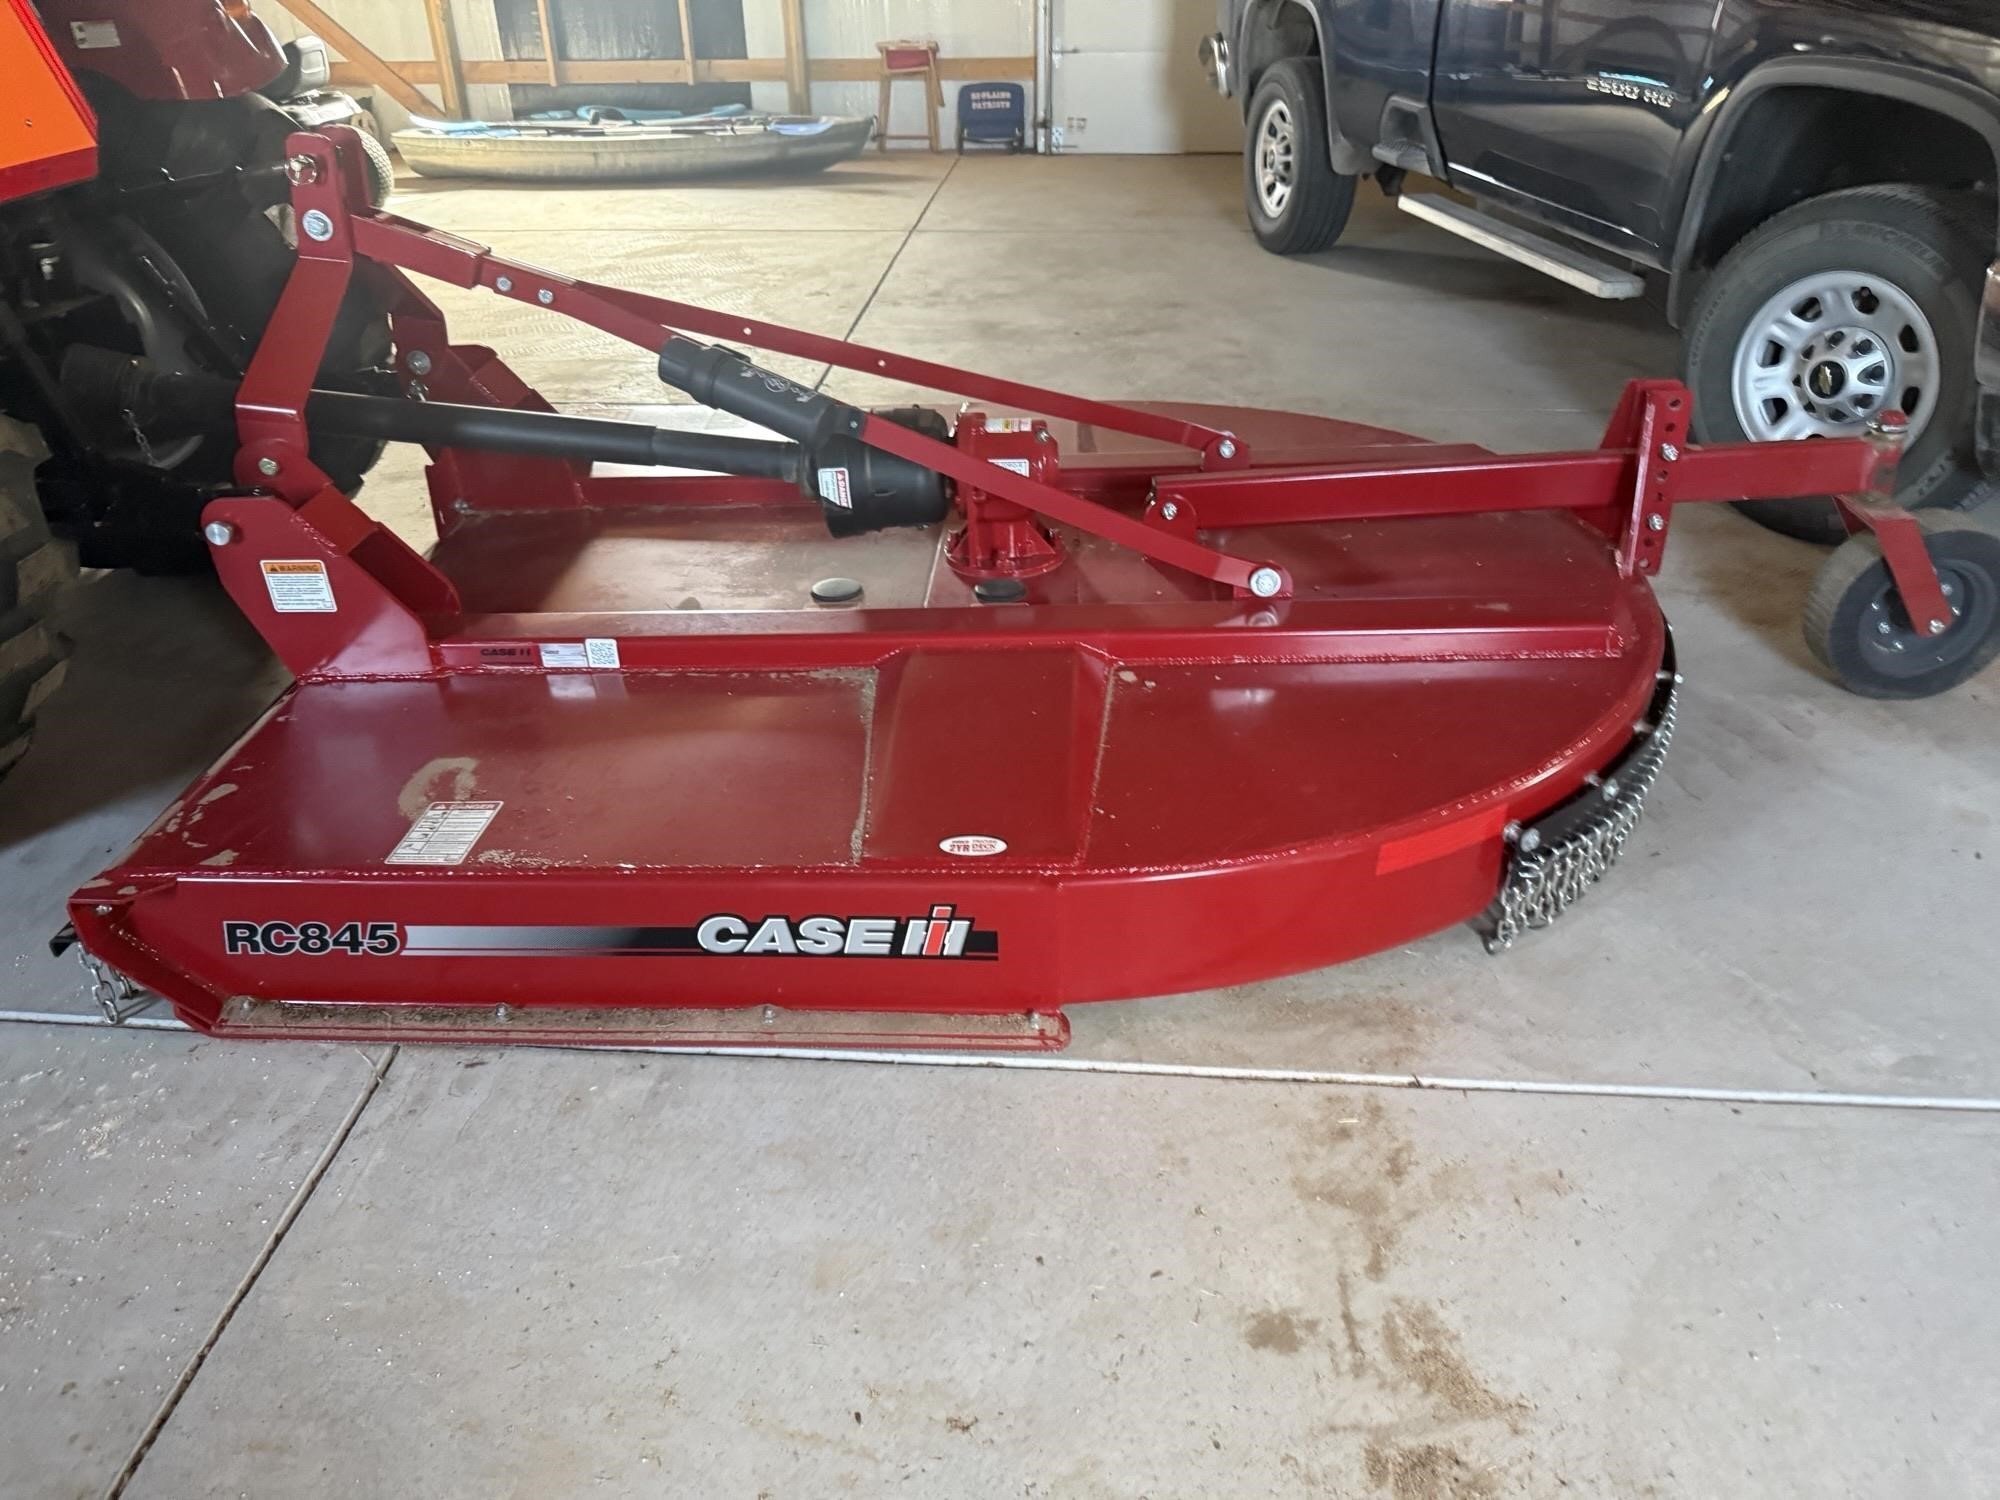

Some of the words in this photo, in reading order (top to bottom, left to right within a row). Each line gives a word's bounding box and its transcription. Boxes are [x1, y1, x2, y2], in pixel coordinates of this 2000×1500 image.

[1586, 79, 1640, 100] 2500
[481, 648, 516, 656] CASE
[223, 921, 400, 955] RC845
[697, 915, 897, 954] CASE
